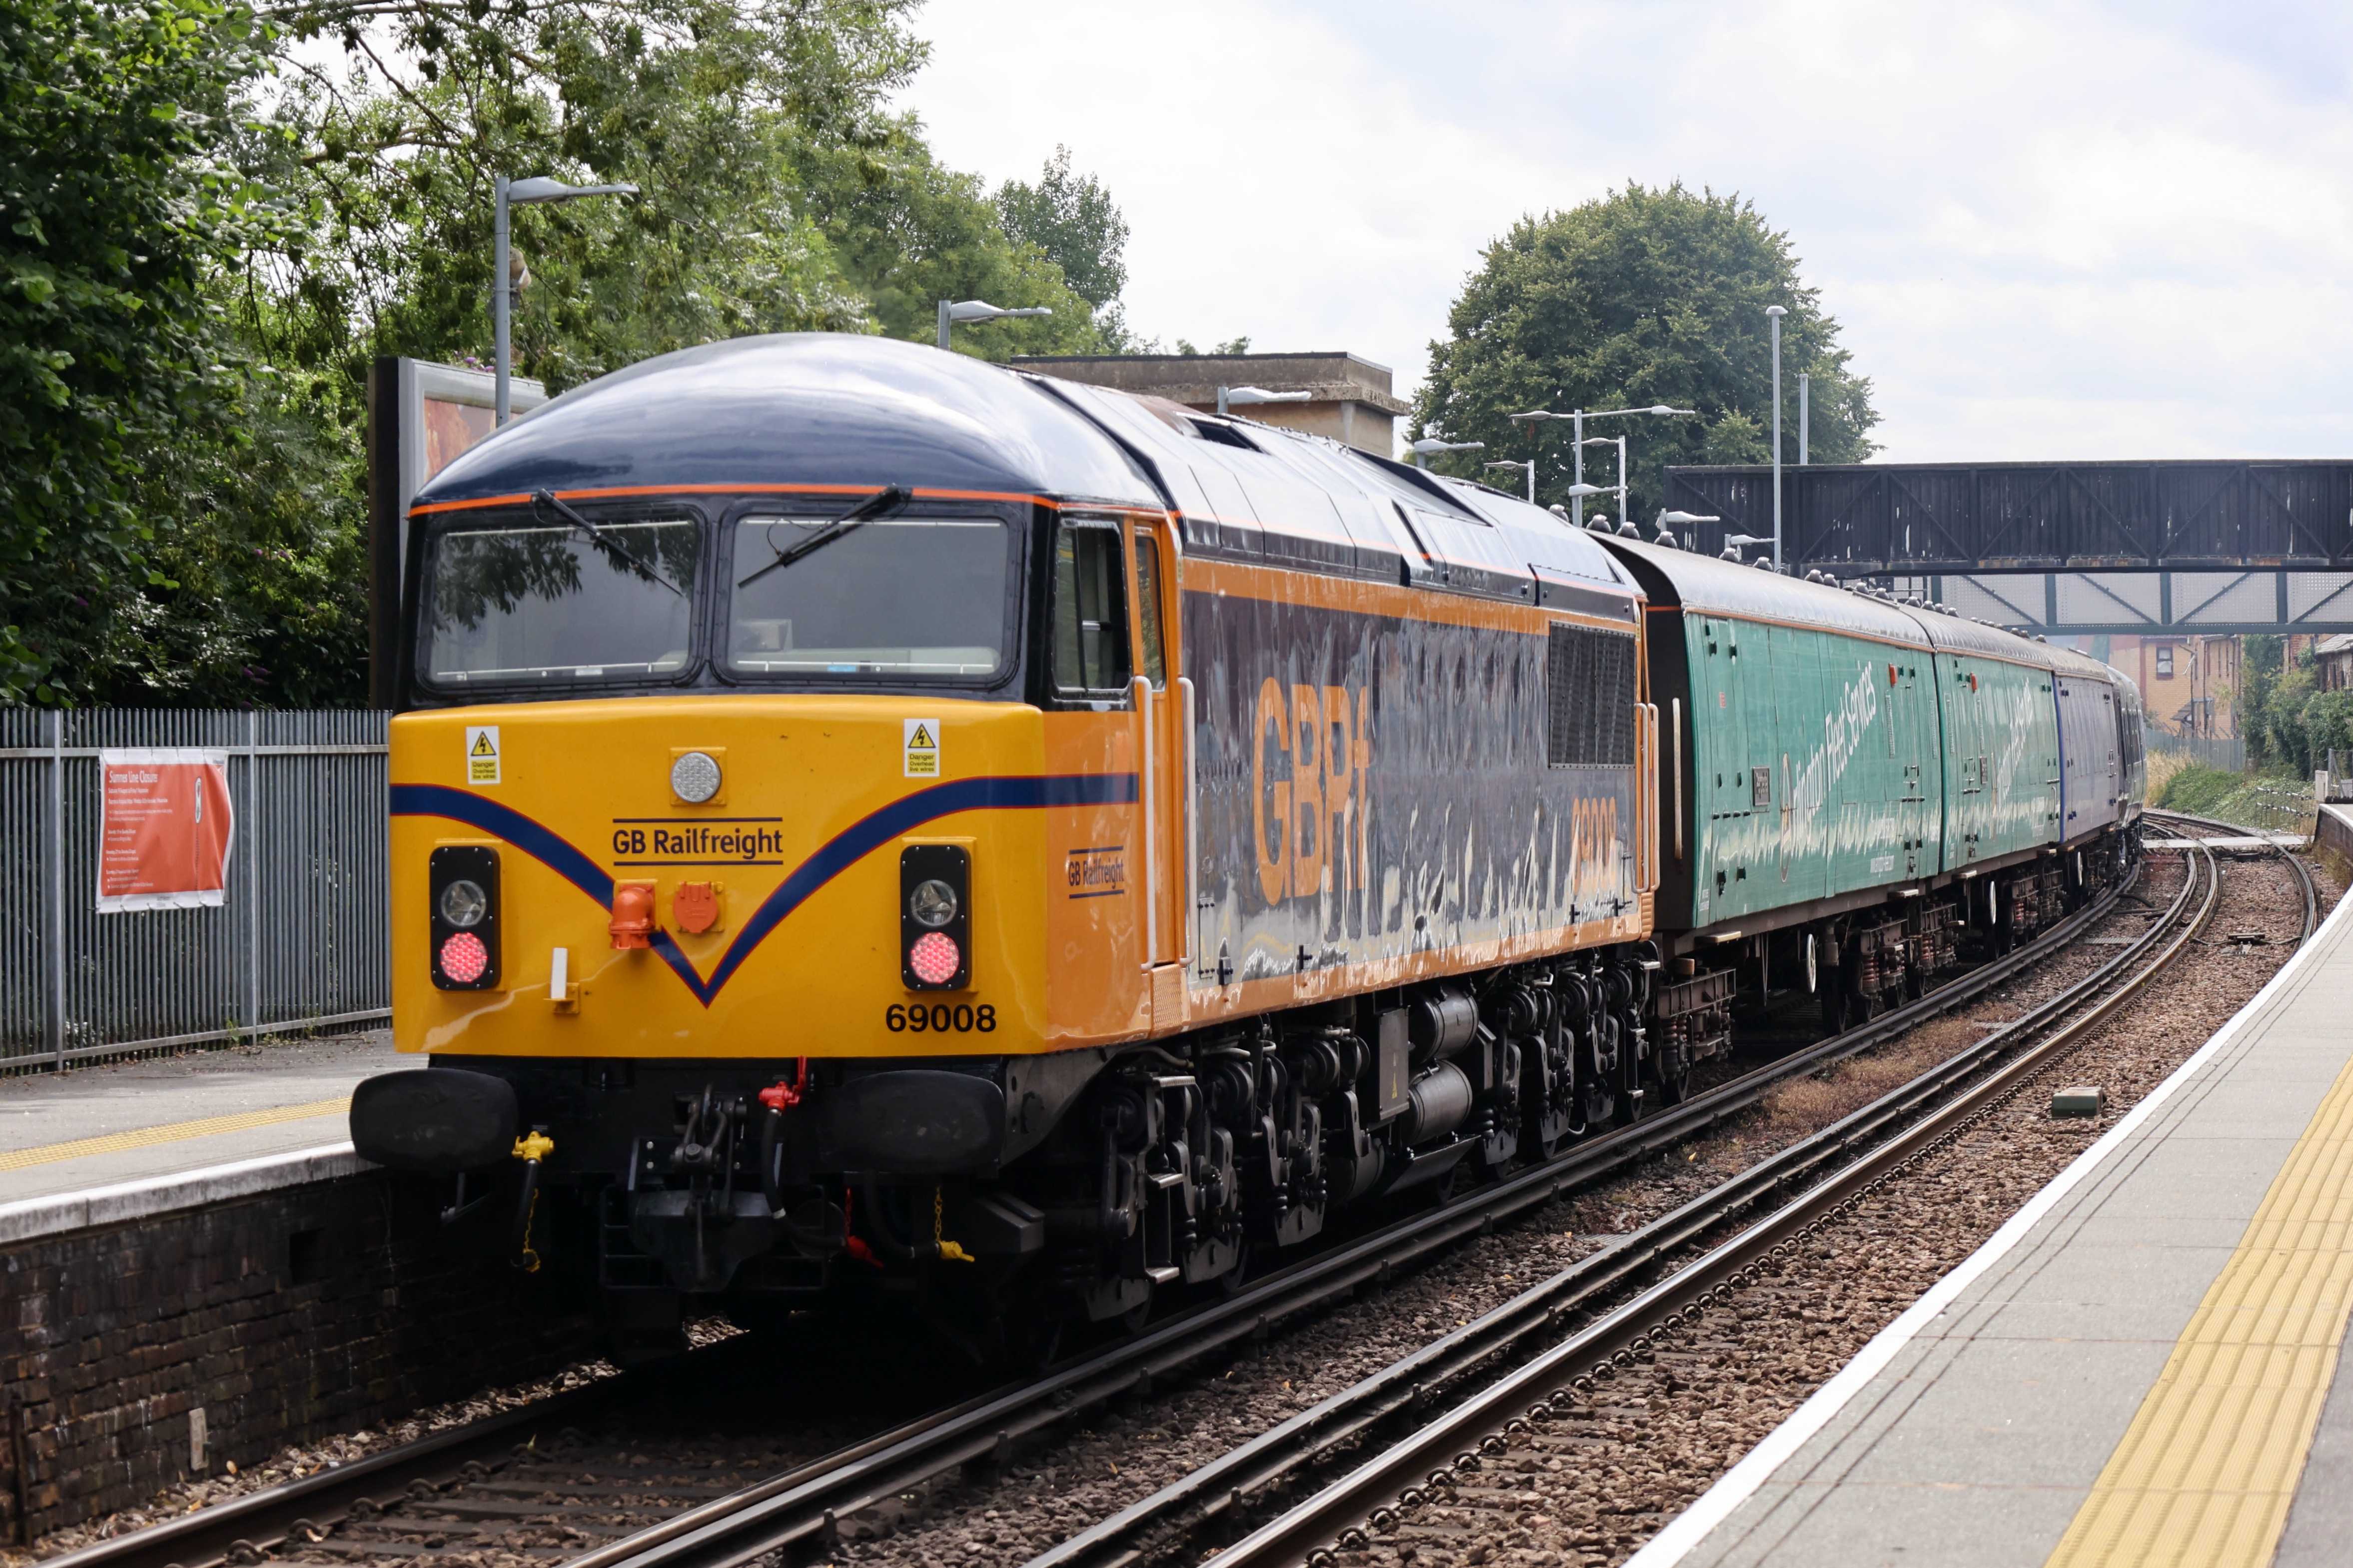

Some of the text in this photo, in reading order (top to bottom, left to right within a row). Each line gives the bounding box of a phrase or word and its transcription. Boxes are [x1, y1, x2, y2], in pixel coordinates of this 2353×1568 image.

[1825, 698, 1847, 792] Fleet
[1844, 661, 1877, 756] Services
[1254, 677, 1369, 905] GBRf
[613, 827, 783, 859] GB Railfreight
[1068, 856, 1124, 889] GB Railfreight
[885, 1003, 996, 1032] 69008
